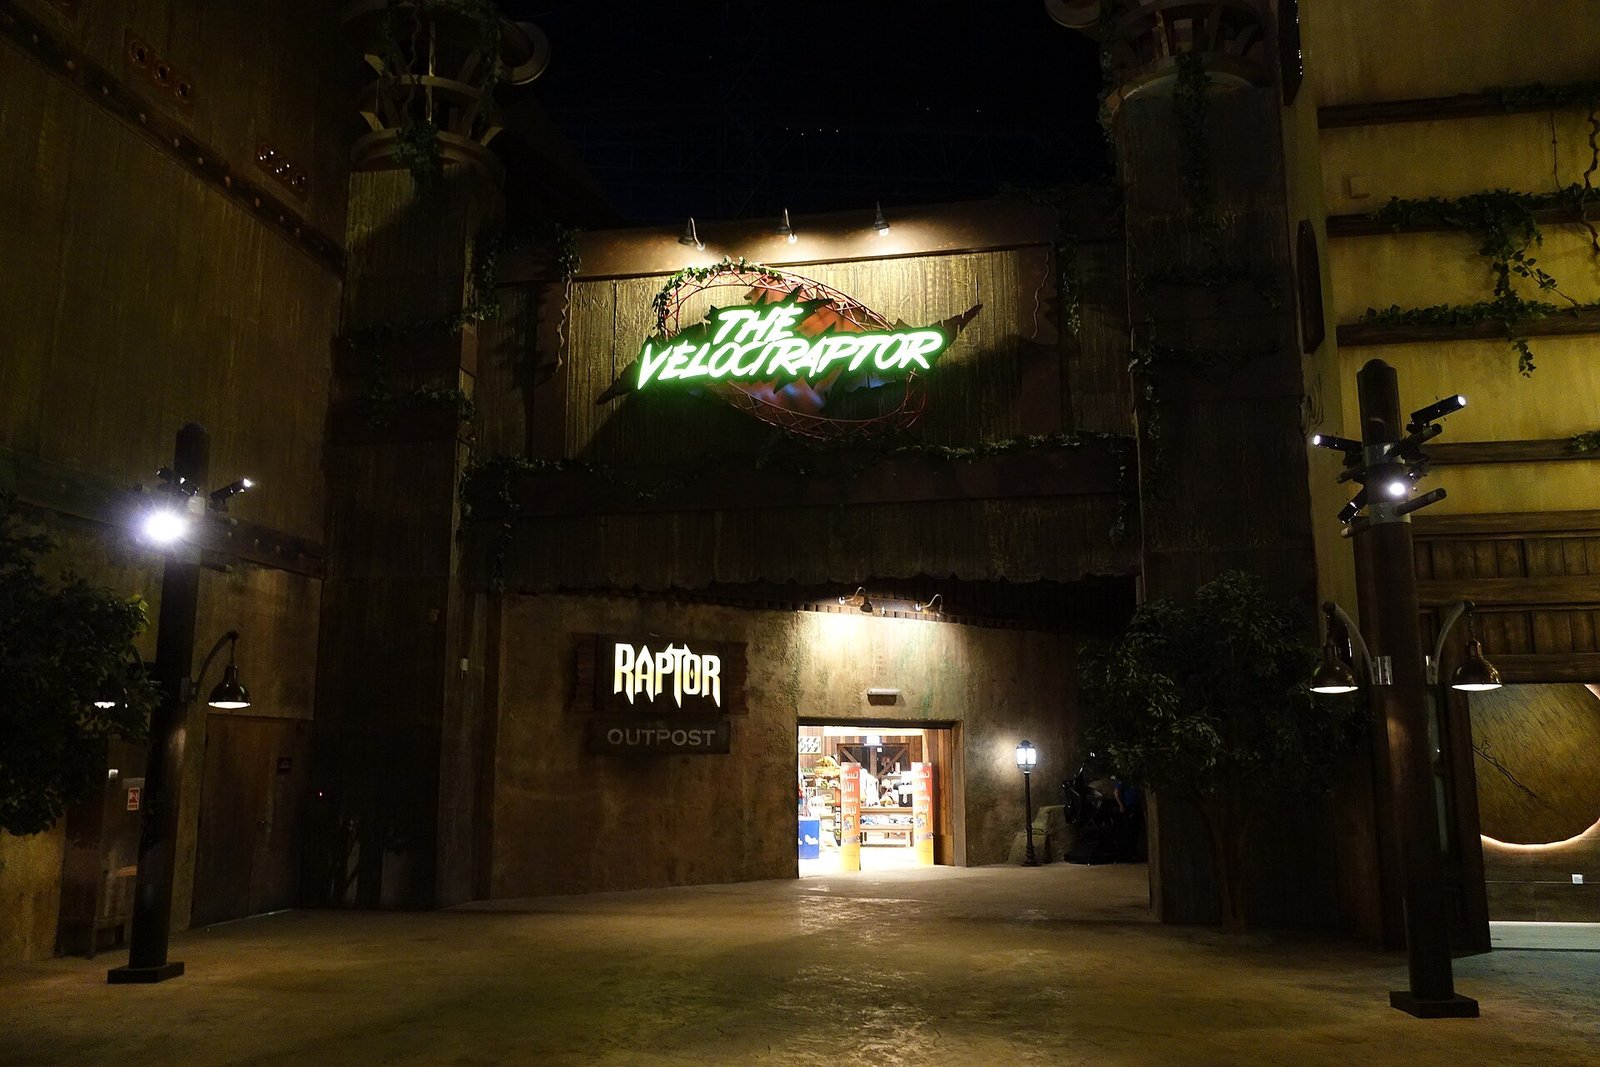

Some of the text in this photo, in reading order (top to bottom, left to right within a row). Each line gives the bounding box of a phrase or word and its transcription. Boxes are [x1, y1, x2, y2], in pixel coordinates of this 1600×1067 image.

[713, 303, 805, 345] THE
[636, 331, 944, 390] VELOCIRAPTOR
[613, 642, 721, 709] RAPTOR
[606, 728, 717, 746] OUTPOST
